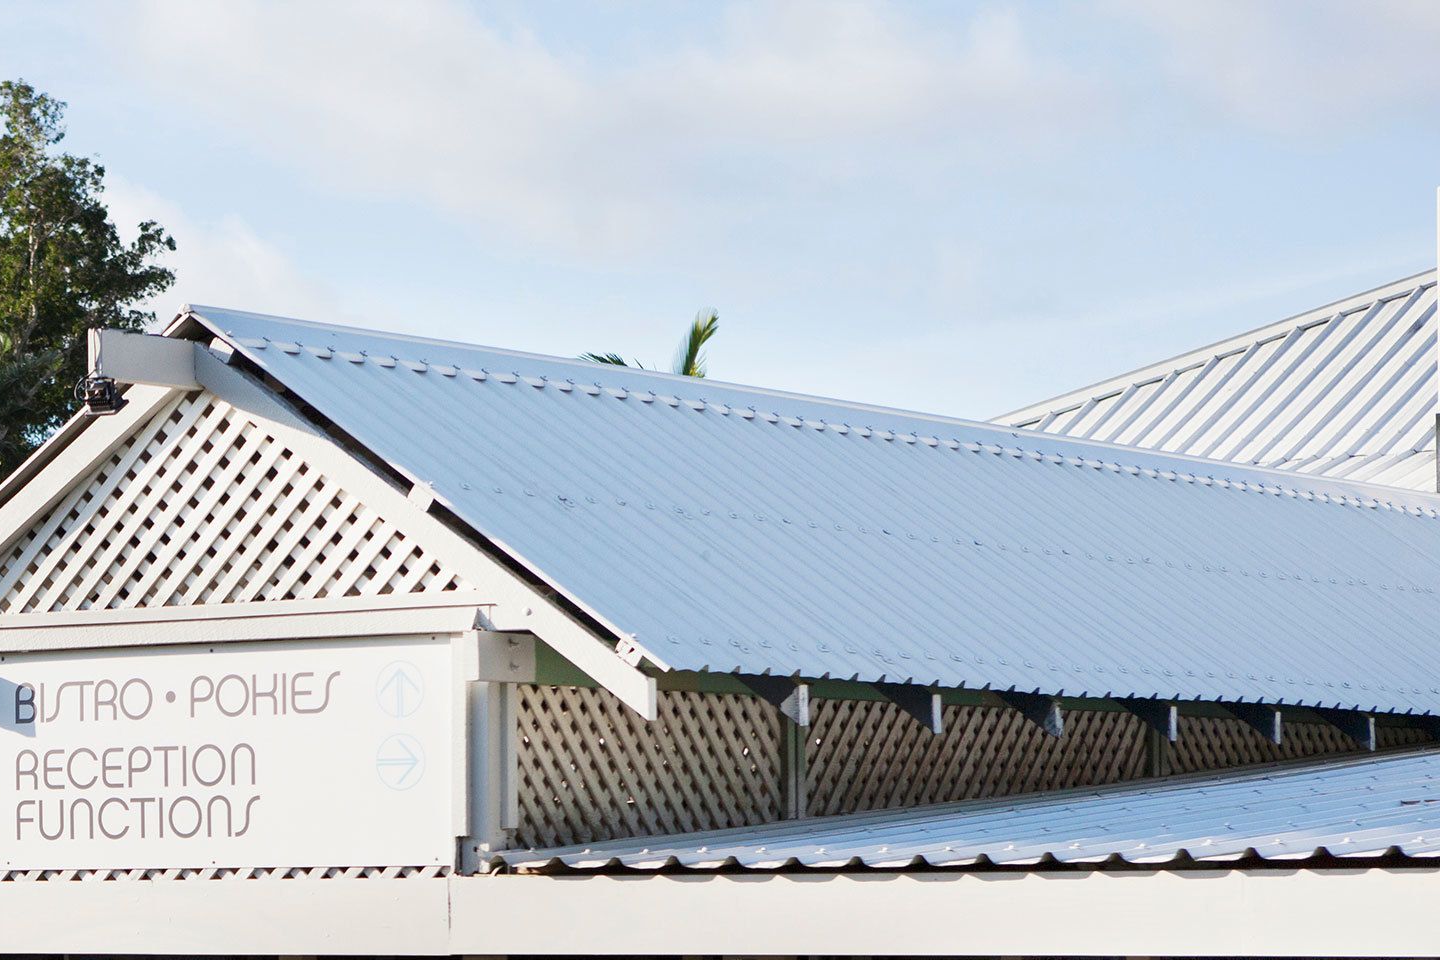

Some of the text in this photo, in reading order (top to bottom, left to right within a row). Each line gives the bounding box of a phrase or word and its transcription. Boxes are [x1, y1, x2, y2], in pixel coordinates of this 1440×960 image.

[15, 670, 341, 724] BISTRO POKIES
[16, 742, 256, 791] RECEPTION
[16, 794, 261, 841] FUNCTIONS
